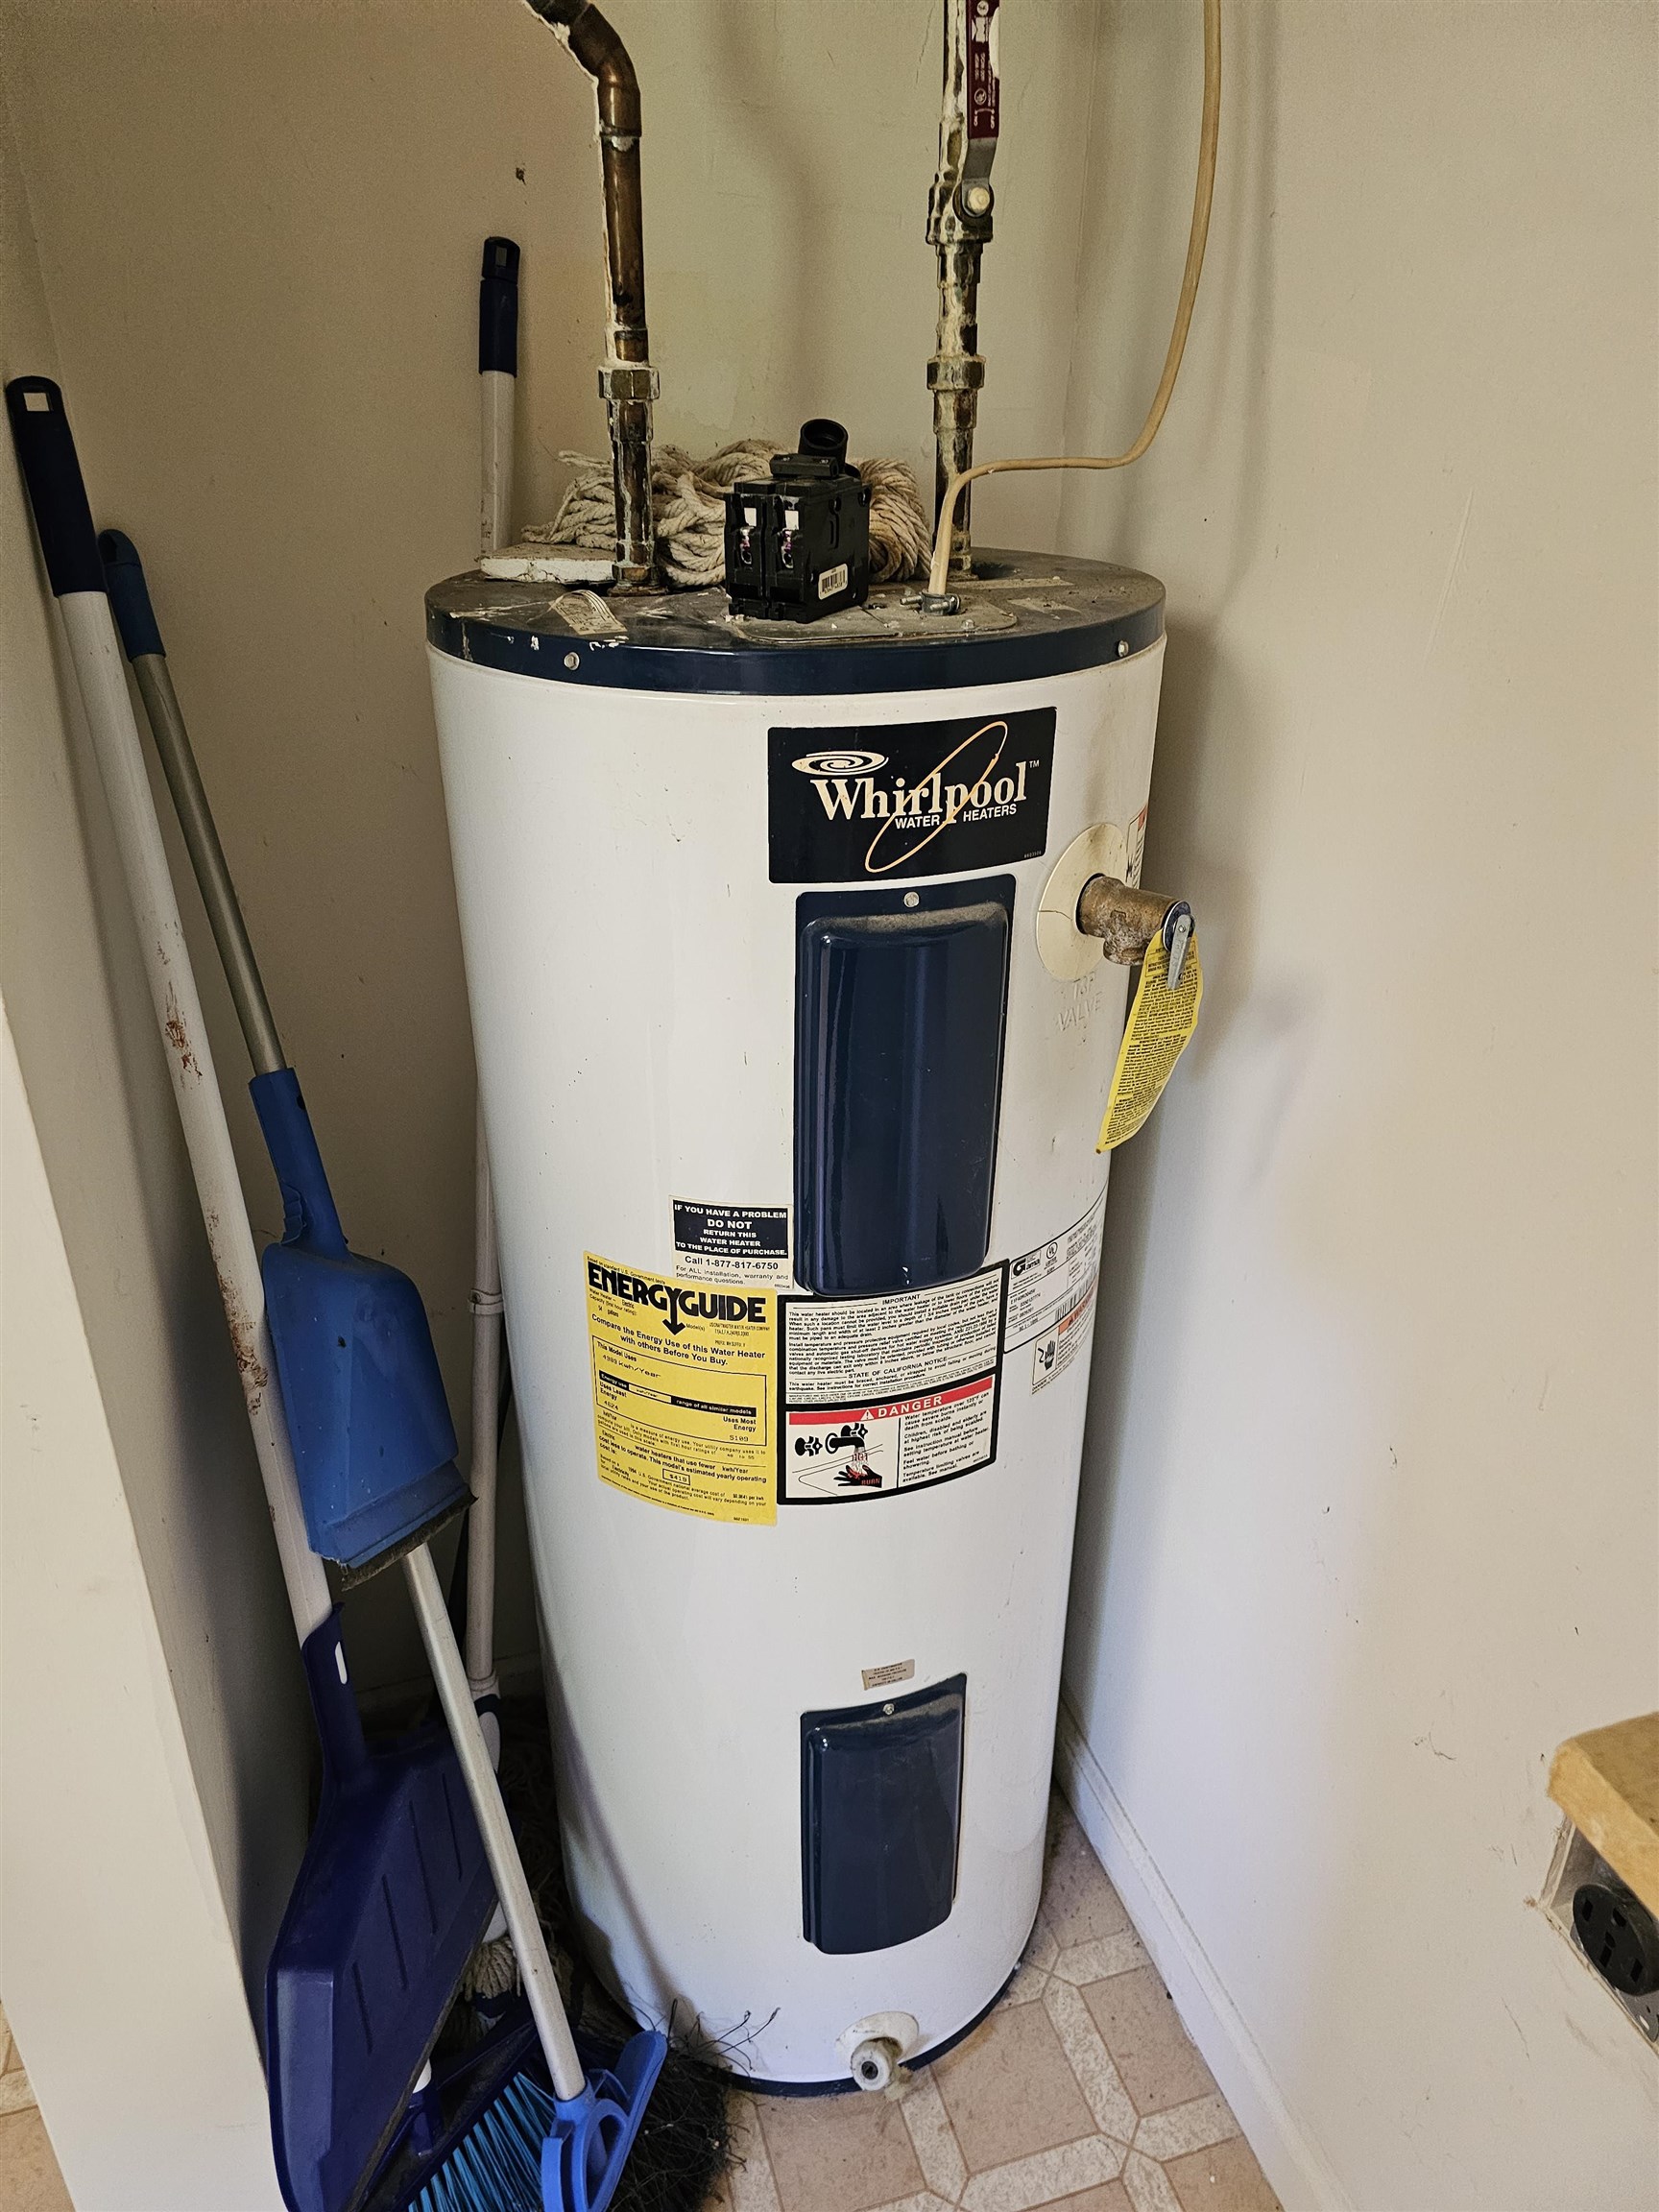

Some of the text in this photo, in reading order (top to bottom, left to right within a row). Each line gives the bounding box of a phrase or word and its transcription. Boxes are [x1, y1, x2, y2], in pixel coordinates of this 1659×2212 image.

[810, 761, 1026, 825] Whirlpool
[895, 805, 1017, 829] WATER HEATERS
[728, 1220, 752, 1229] NOT
[685, 1256, 778, 1270] Call 1-877-817-6750
[704, 1270, 741, 1279] installation,
[588, 1261, 766, 1327] ENERGYGUIDE
[882, 1294, 921, 1305] IMPORTANT
[592, 1314, 621, 1331] Compare
[623, 1326, 634, 1335] the
[637, 1331, 662, 1344] Energy
[664, 1338, 680, 1347] Use
[710, 1347, 734, 1356] Water
[597, 1341, 637, 1361] This Model Uses
[620, 1335, 636, 1345] with
[637, 1342, 661, 1353] others
[663, 1347, 688, 1358] Before
[710, 1356, 728, 1365] Buy.
[883, 1363, 923, 1374] CALIFORNIA
[925, 1357, 948, 1365] NOTICE
[601, 1373, 617, 1384] Energy
[600, 1381, 626, 1397] Uses Least
[600, 1387, 617, 1401] Energy
[878, 1396, 942, 1417] DANGER
[923, 1406, 951, 1416] temperature
[957, 1403, 976, 1411] instantly
[733, 1424, 756, 1432] Energy
[929, 1424, 950, 1432] disabled
[916, 1439, 942, 1449] instruction
[924, 1441, 952, 1453] temperature
[599, 1435, 610, 1444] cost
[611, 1440, 619, 1450] less
[649, 1456, 661, 1465] This
[662, 1461, 685, 1472] model's
[686, 1467, 715, 1478] estimated
[716, 1472, 734, 1480] yearly
[635, 1445, 649, 1454] water
[651, 1450, 672, 1460] heaters
[903, 1466, 934, 1477] Temperature
